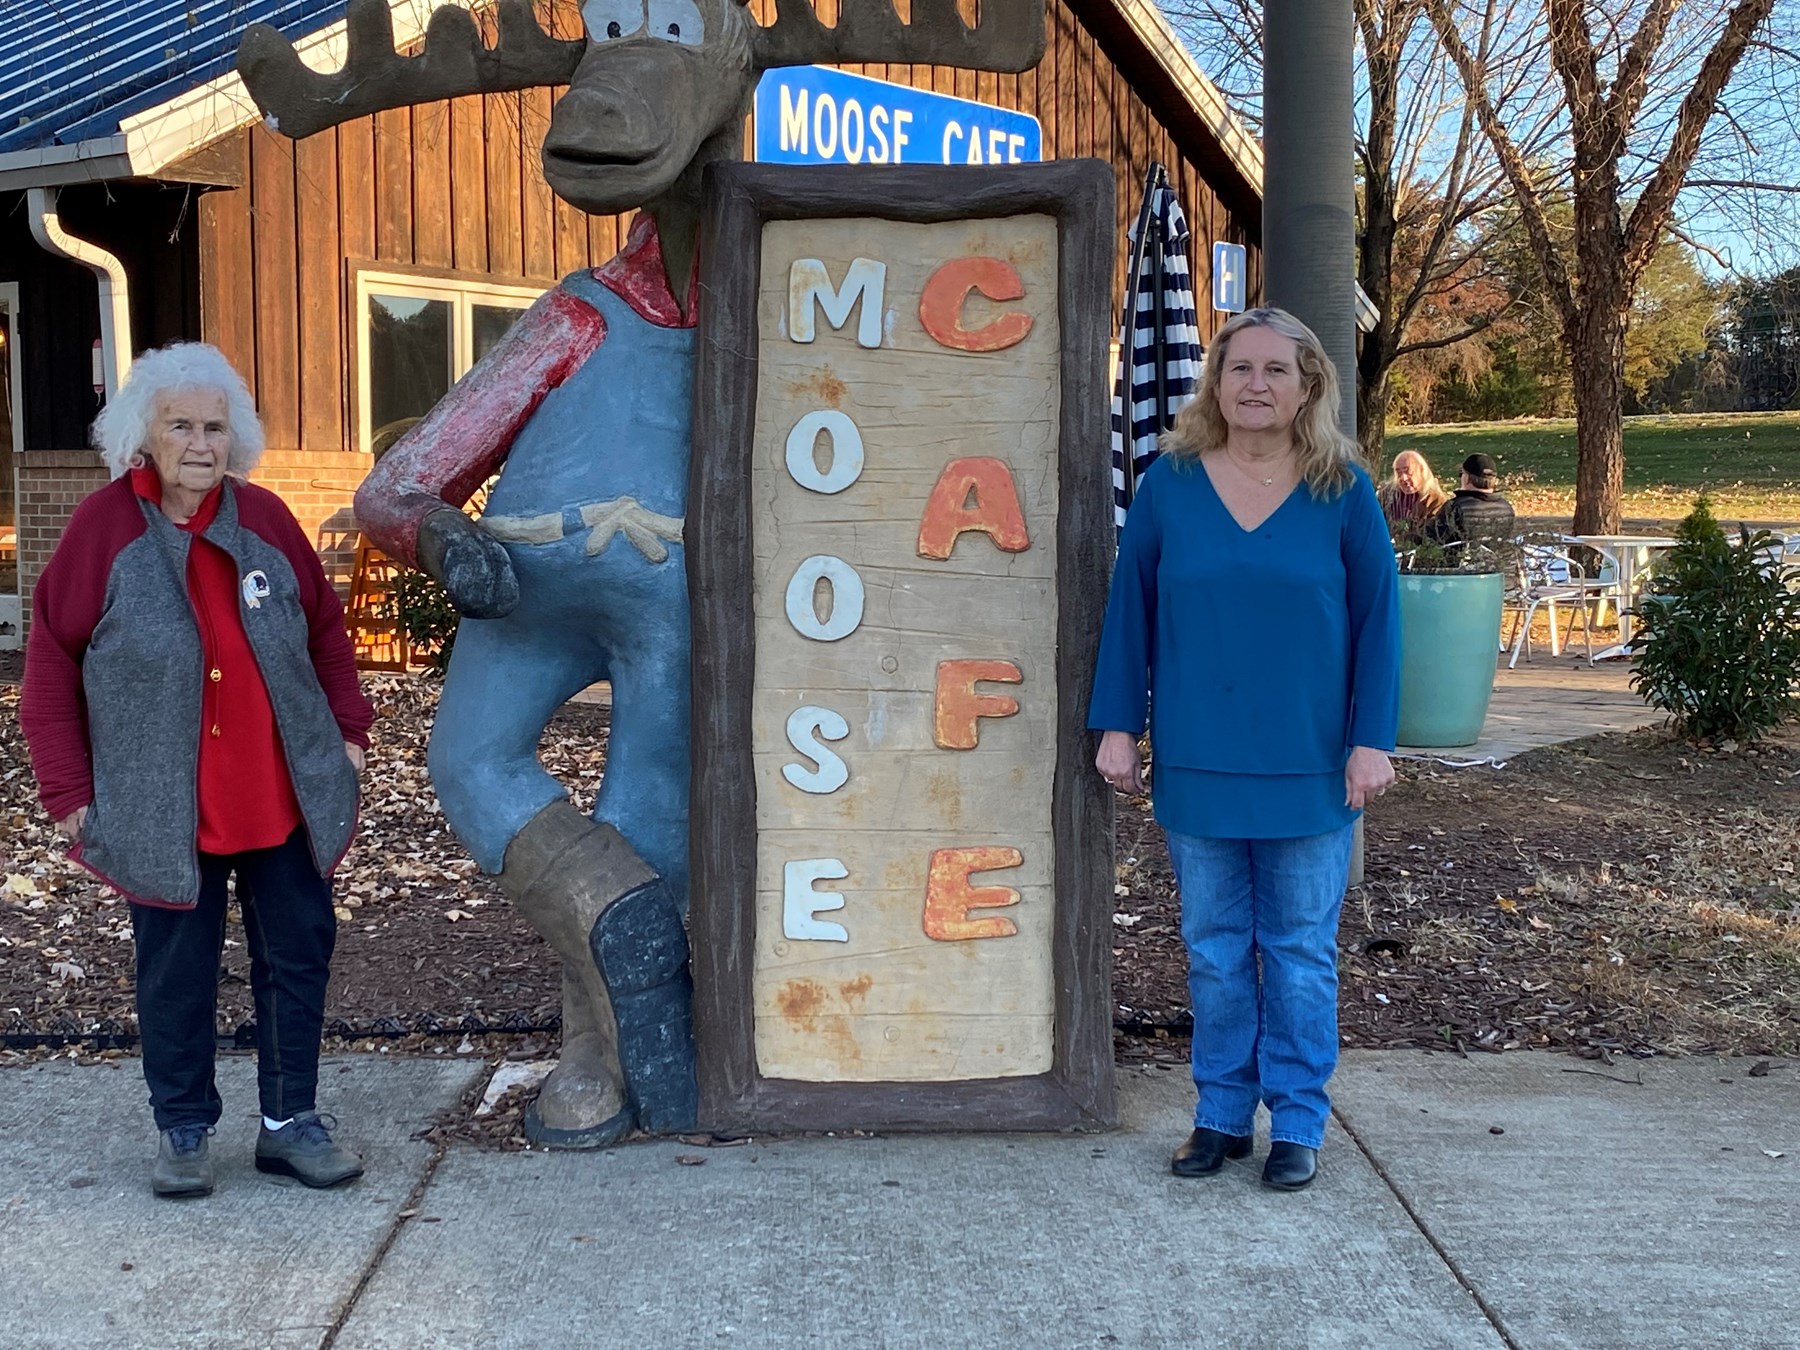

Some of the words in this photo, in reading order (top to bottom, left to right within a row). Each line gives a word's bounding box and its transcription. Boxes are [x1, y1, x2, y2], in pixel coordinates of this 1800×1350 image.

[780, 84, 913, 164] MOOSE
[942, 120, 1025, 164] CAFE
[781, 256, 887, 942] MOOSE
[916, 255, 1034, 942] CAFE
